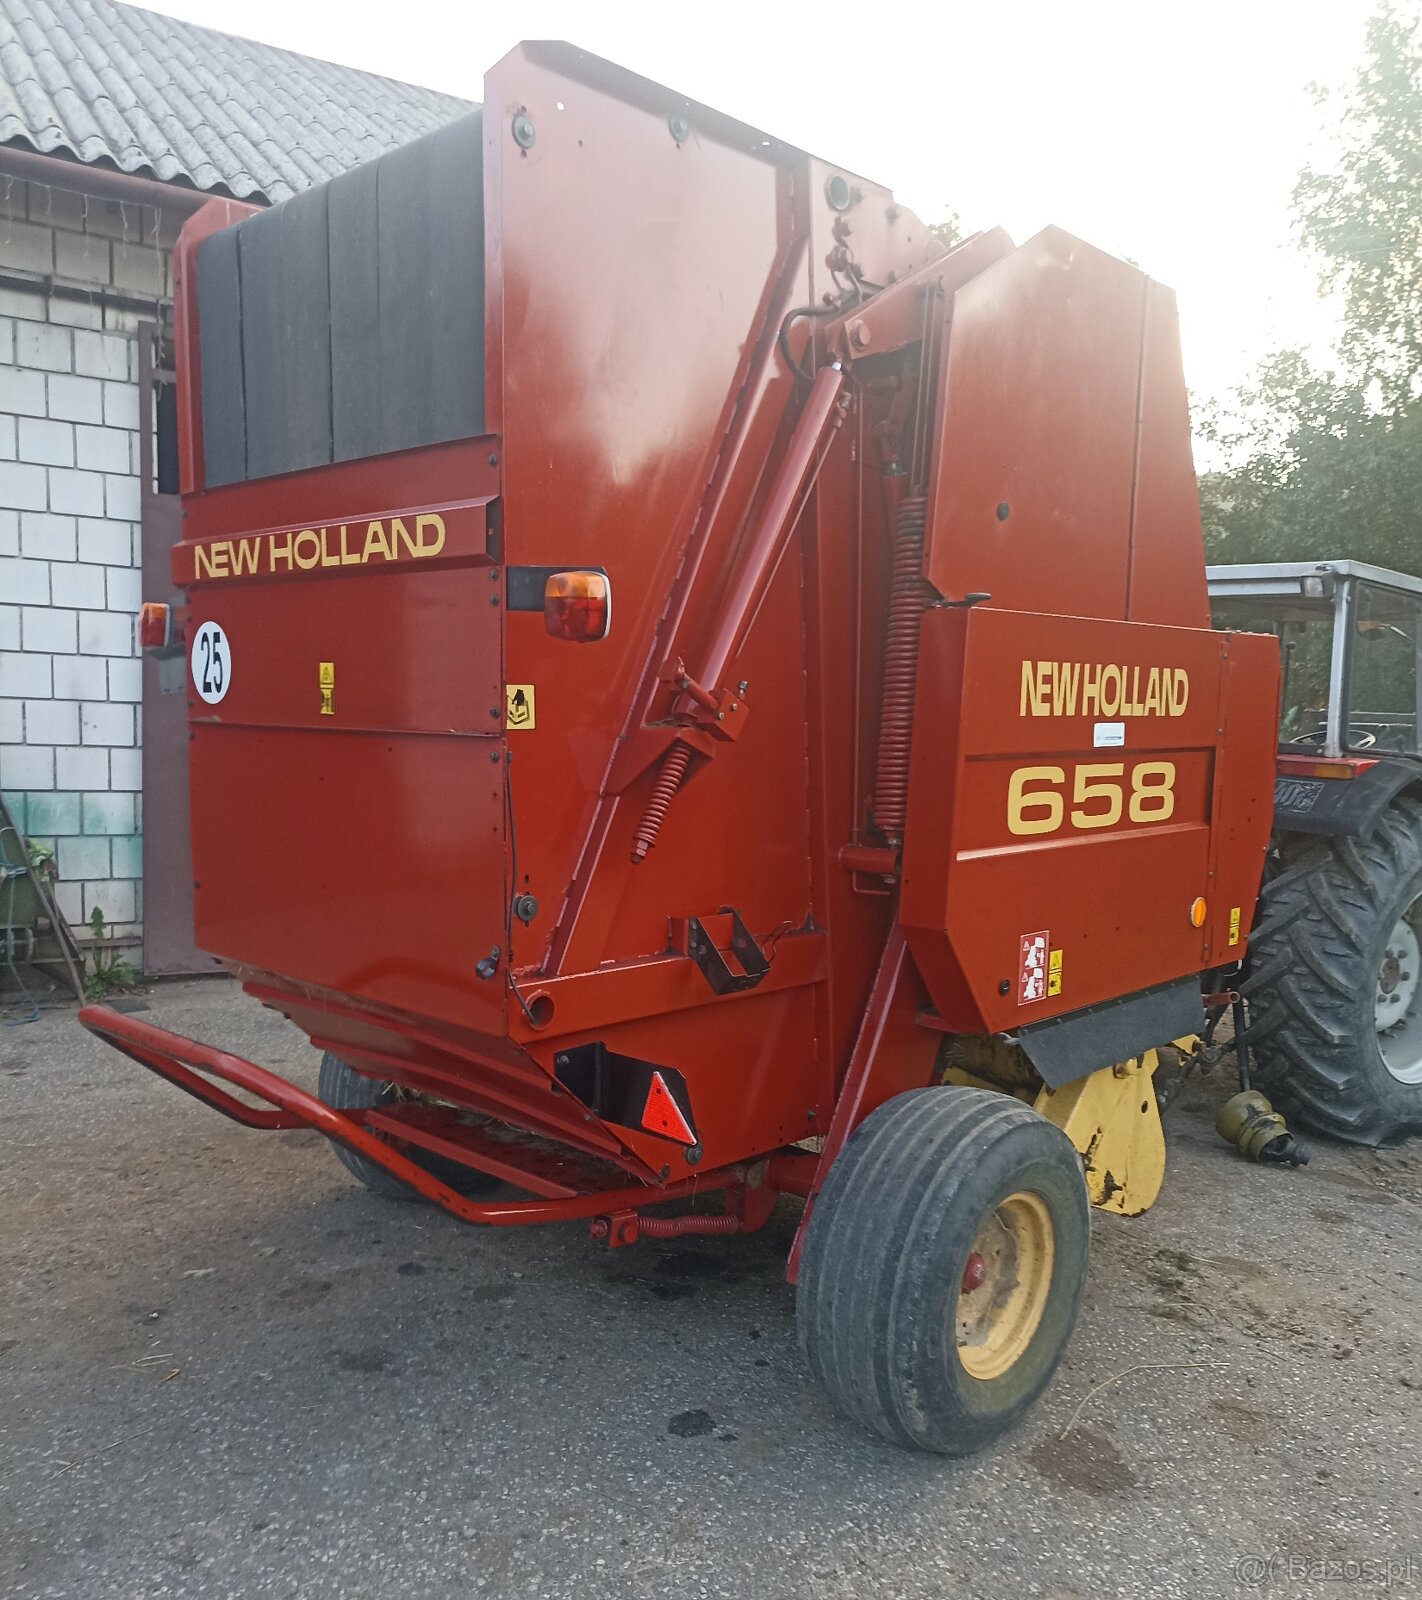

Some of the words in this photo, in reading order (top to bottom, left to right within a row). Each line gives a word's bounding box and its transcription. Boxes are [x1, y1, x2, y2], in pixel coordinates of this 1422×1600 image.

[194, 537, 261, 580] NEW
[269, 513, 446, 572] HOLLAND
[200, 631, 224, 694] 25
[1019, 660, 1081, 717] NEW
[1082, 663, 1189, 717] HOLLAND
[1007, 761, 1176, 835] 658
